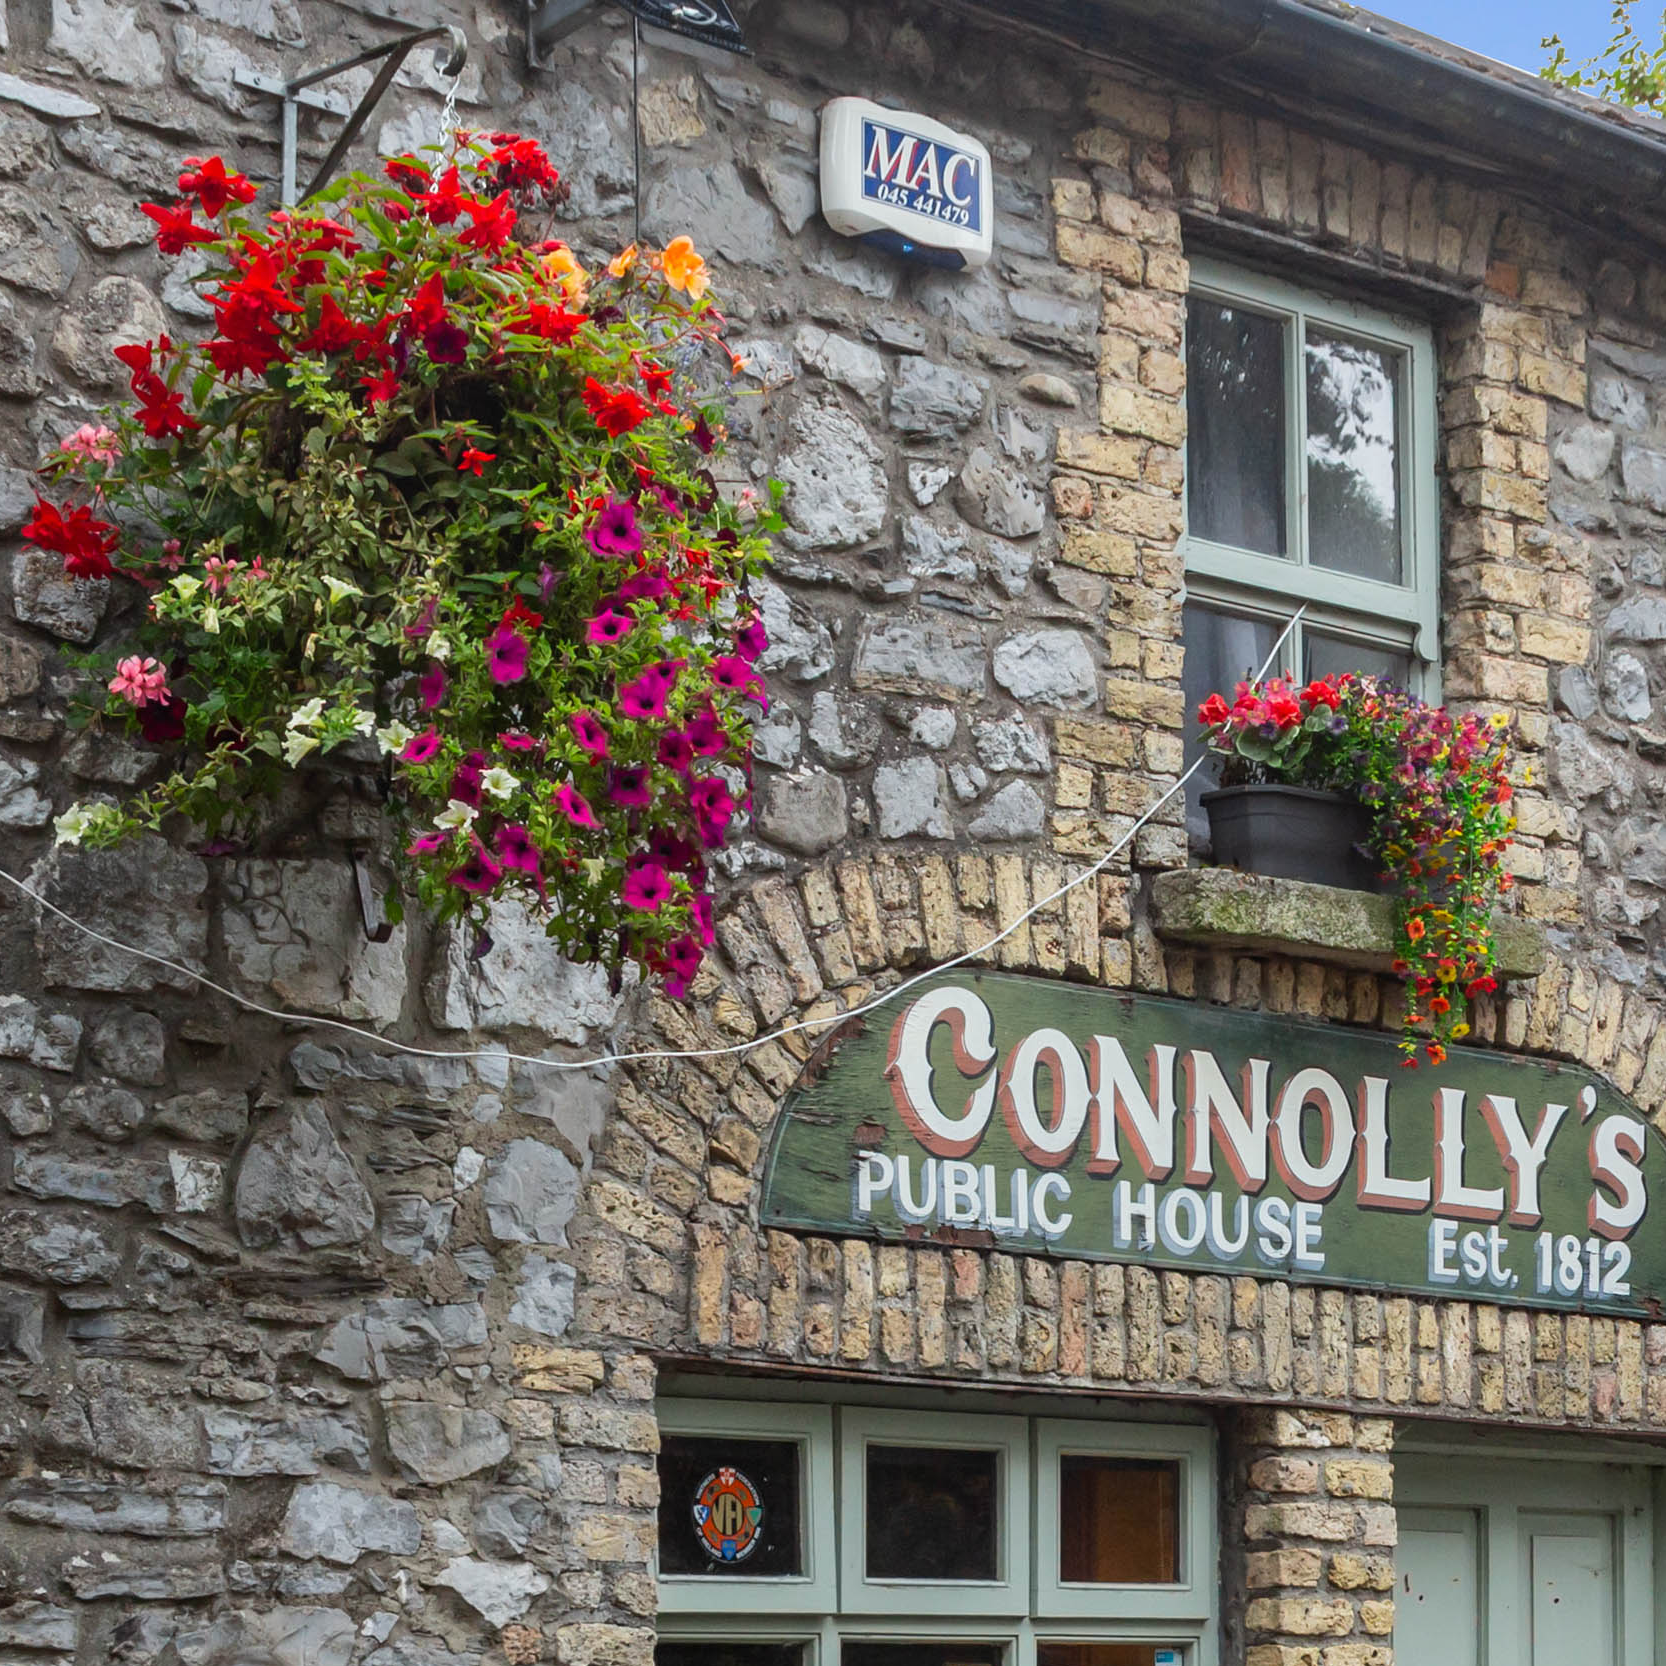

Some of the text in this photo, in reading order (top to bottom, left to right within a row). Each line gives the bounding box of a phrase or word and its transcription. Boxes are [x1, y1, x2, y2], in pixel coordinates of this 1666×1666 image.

[864, 125, 976, 206] MAC
[877, 184, 969, 226] 045 441479
[886, 986, 1647, 1237] CONNOLLY'S
[853, 1150, 1325, 1270] PUBLIC HOUSE
[1536, 1231, 1631, 1297] 1812
